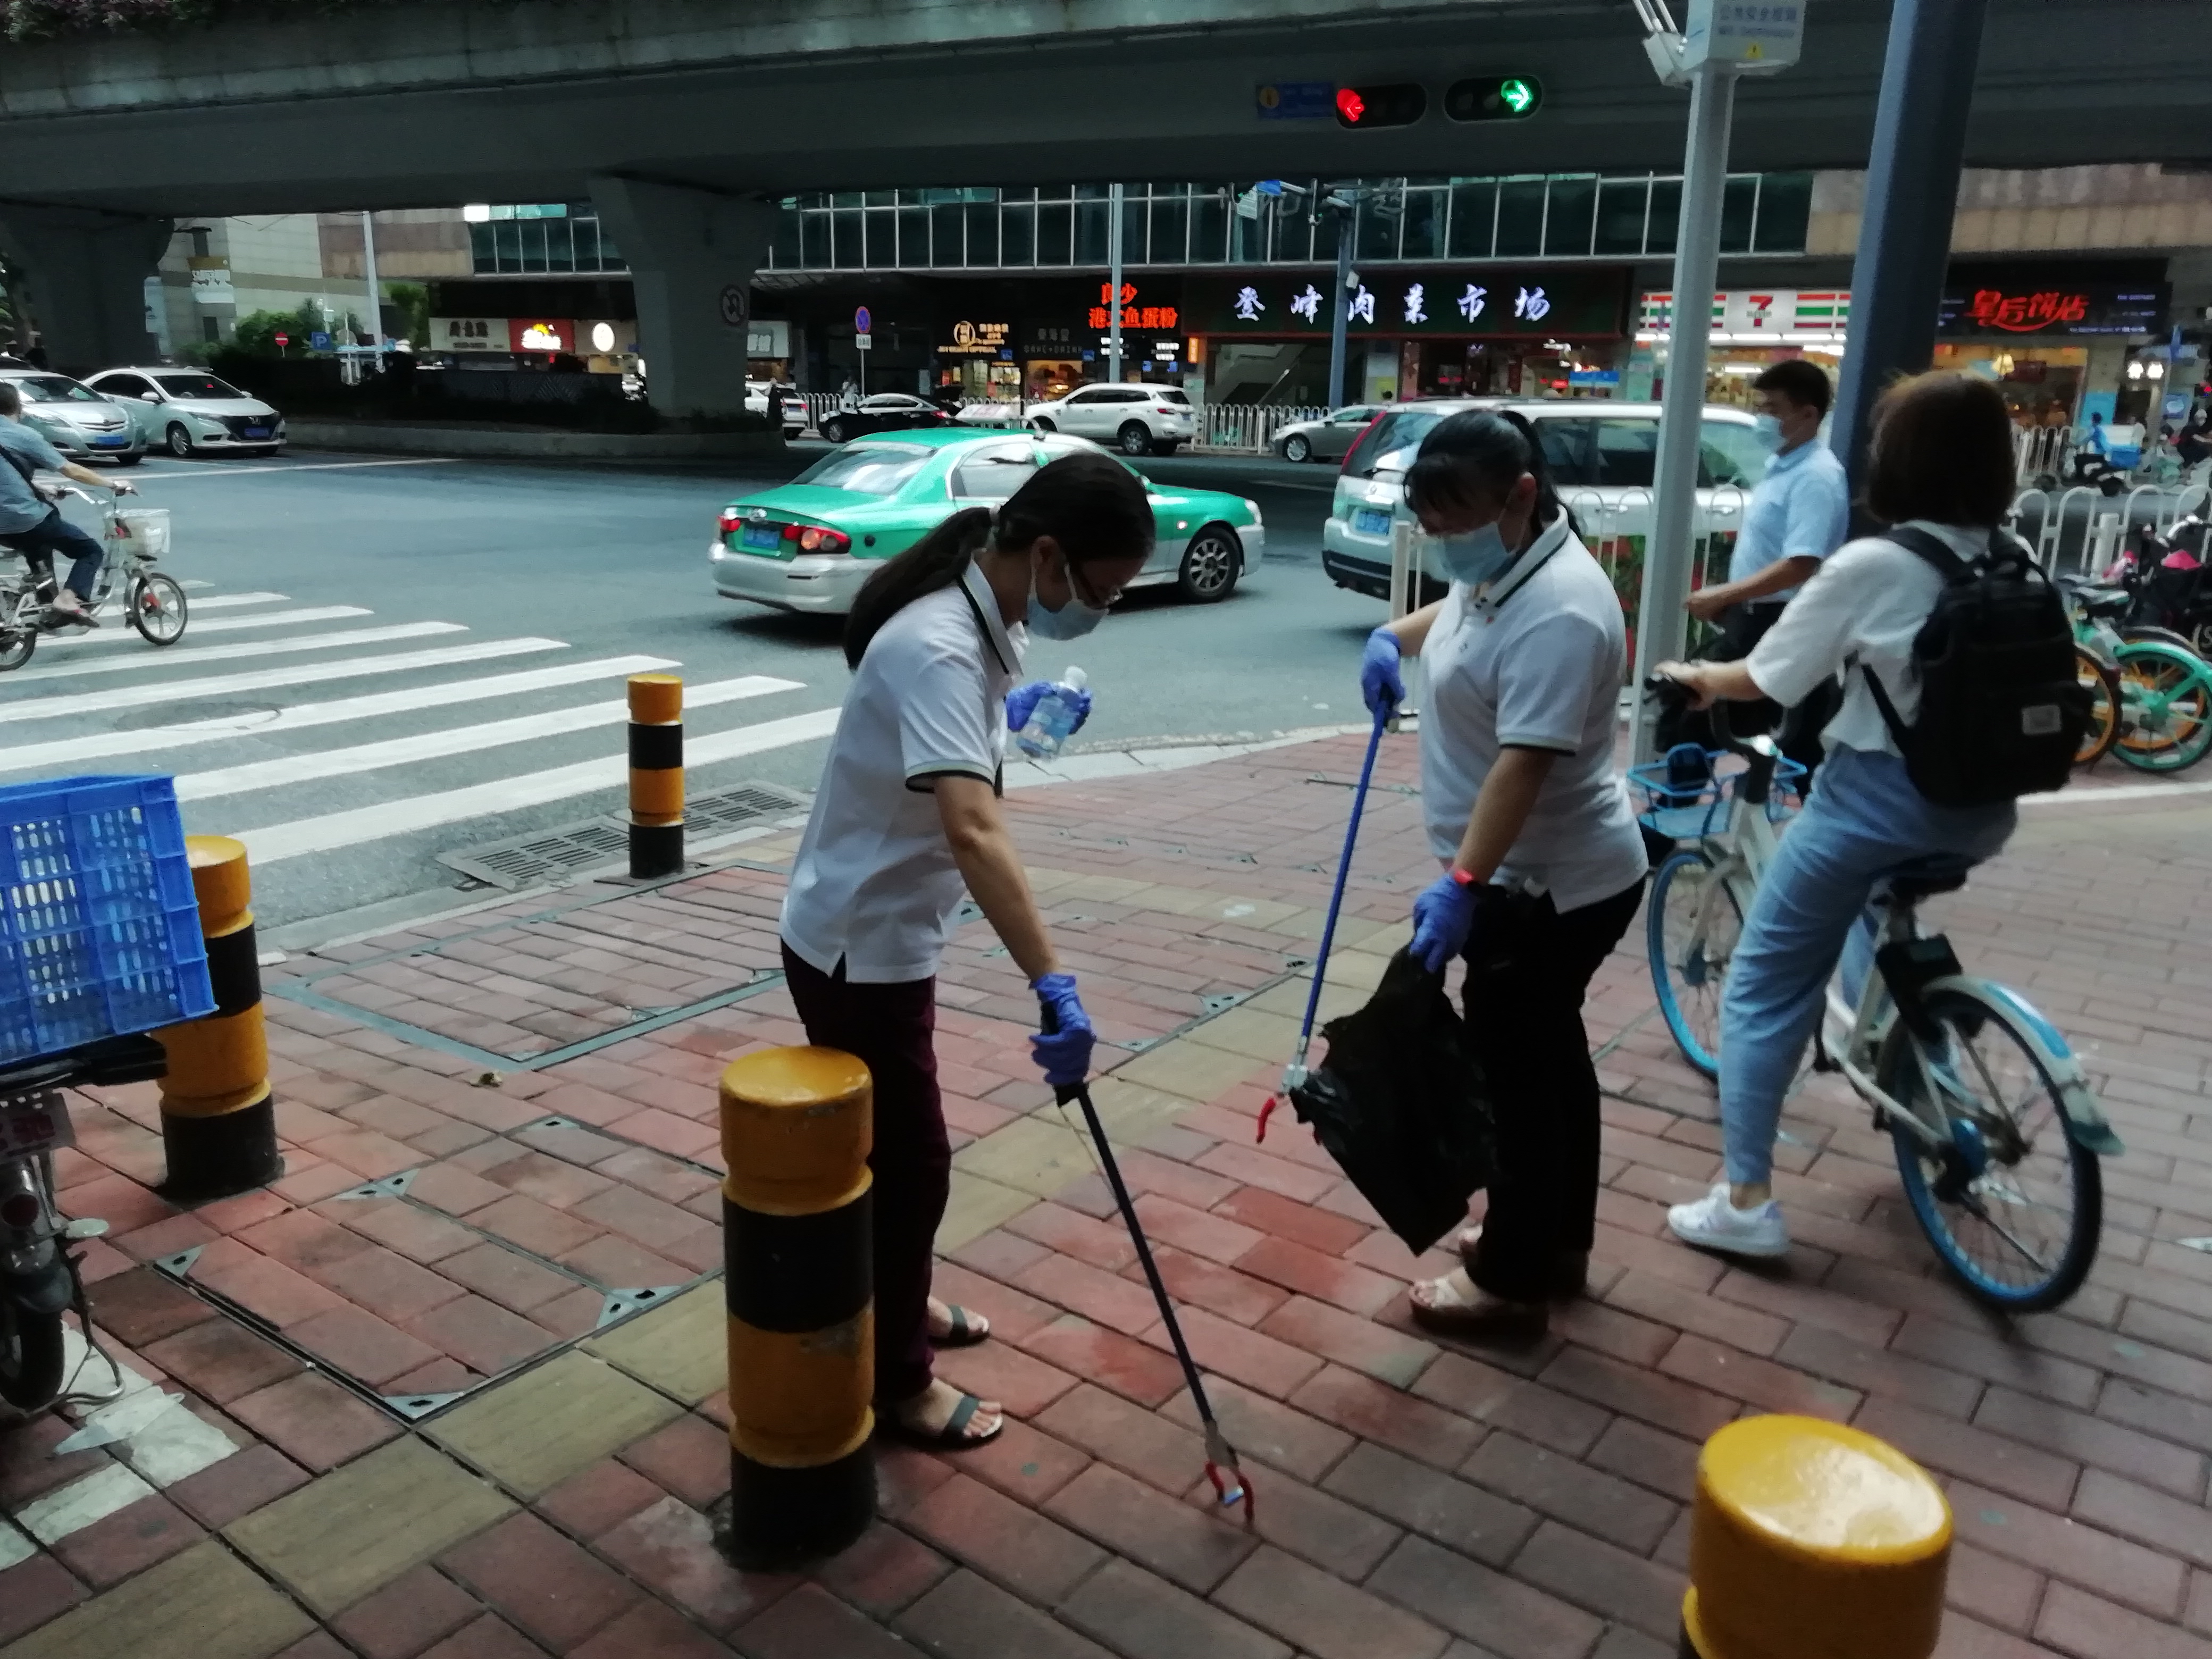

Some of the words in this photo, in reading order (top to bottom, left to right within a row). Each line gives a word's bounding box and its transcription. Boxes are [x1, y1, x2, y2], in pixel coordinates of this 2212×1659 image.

[1233, 283, 1551, 324] 登峰肉菜市场
[316, 335, 328, 347] P
